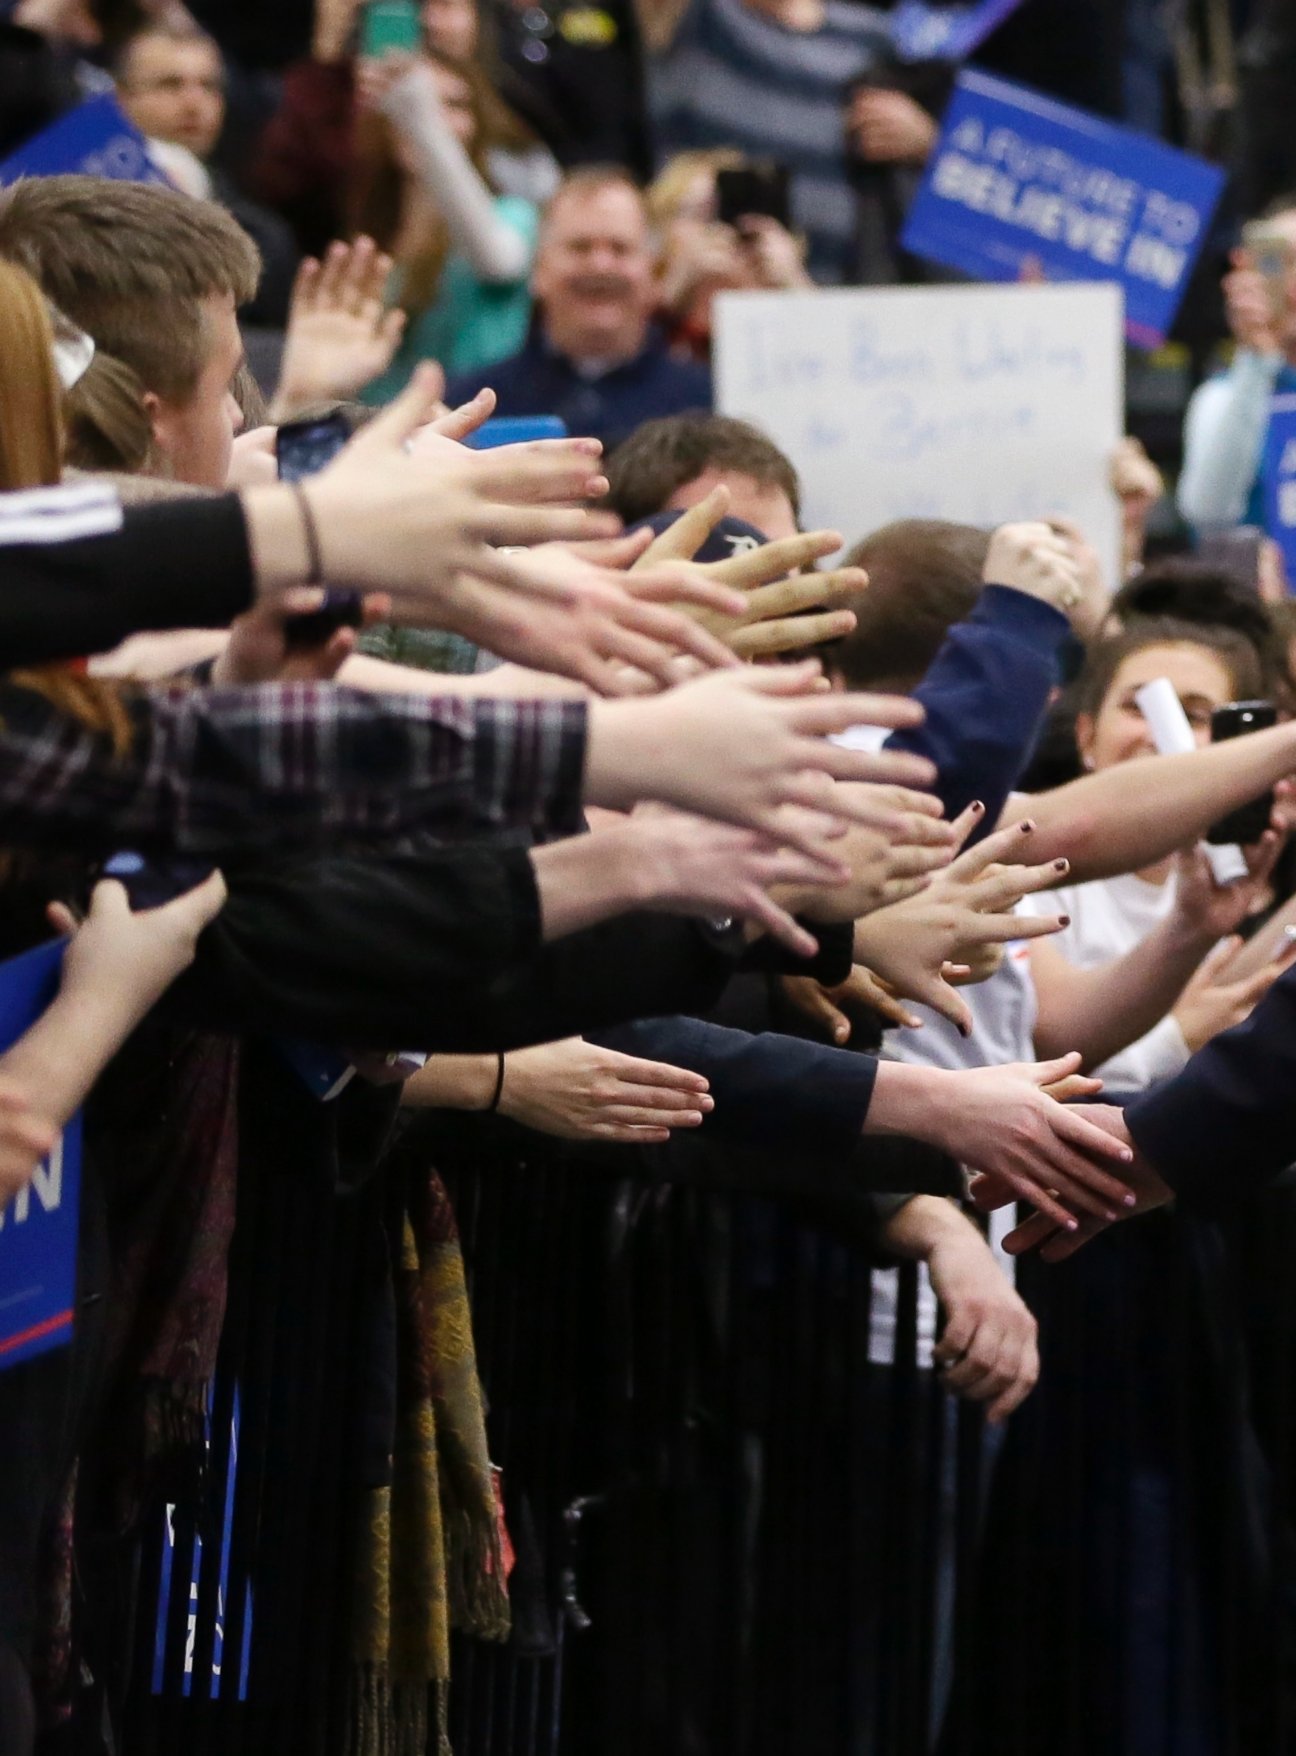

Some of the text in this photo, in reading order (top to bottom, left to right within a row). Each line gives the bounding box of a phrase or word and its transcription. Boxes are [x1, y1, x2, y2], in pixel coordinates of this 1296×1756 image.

[933, 153, 1187, 288] BELIEVE IN
[952, 117, 1201, 247] A FUTURE TO
